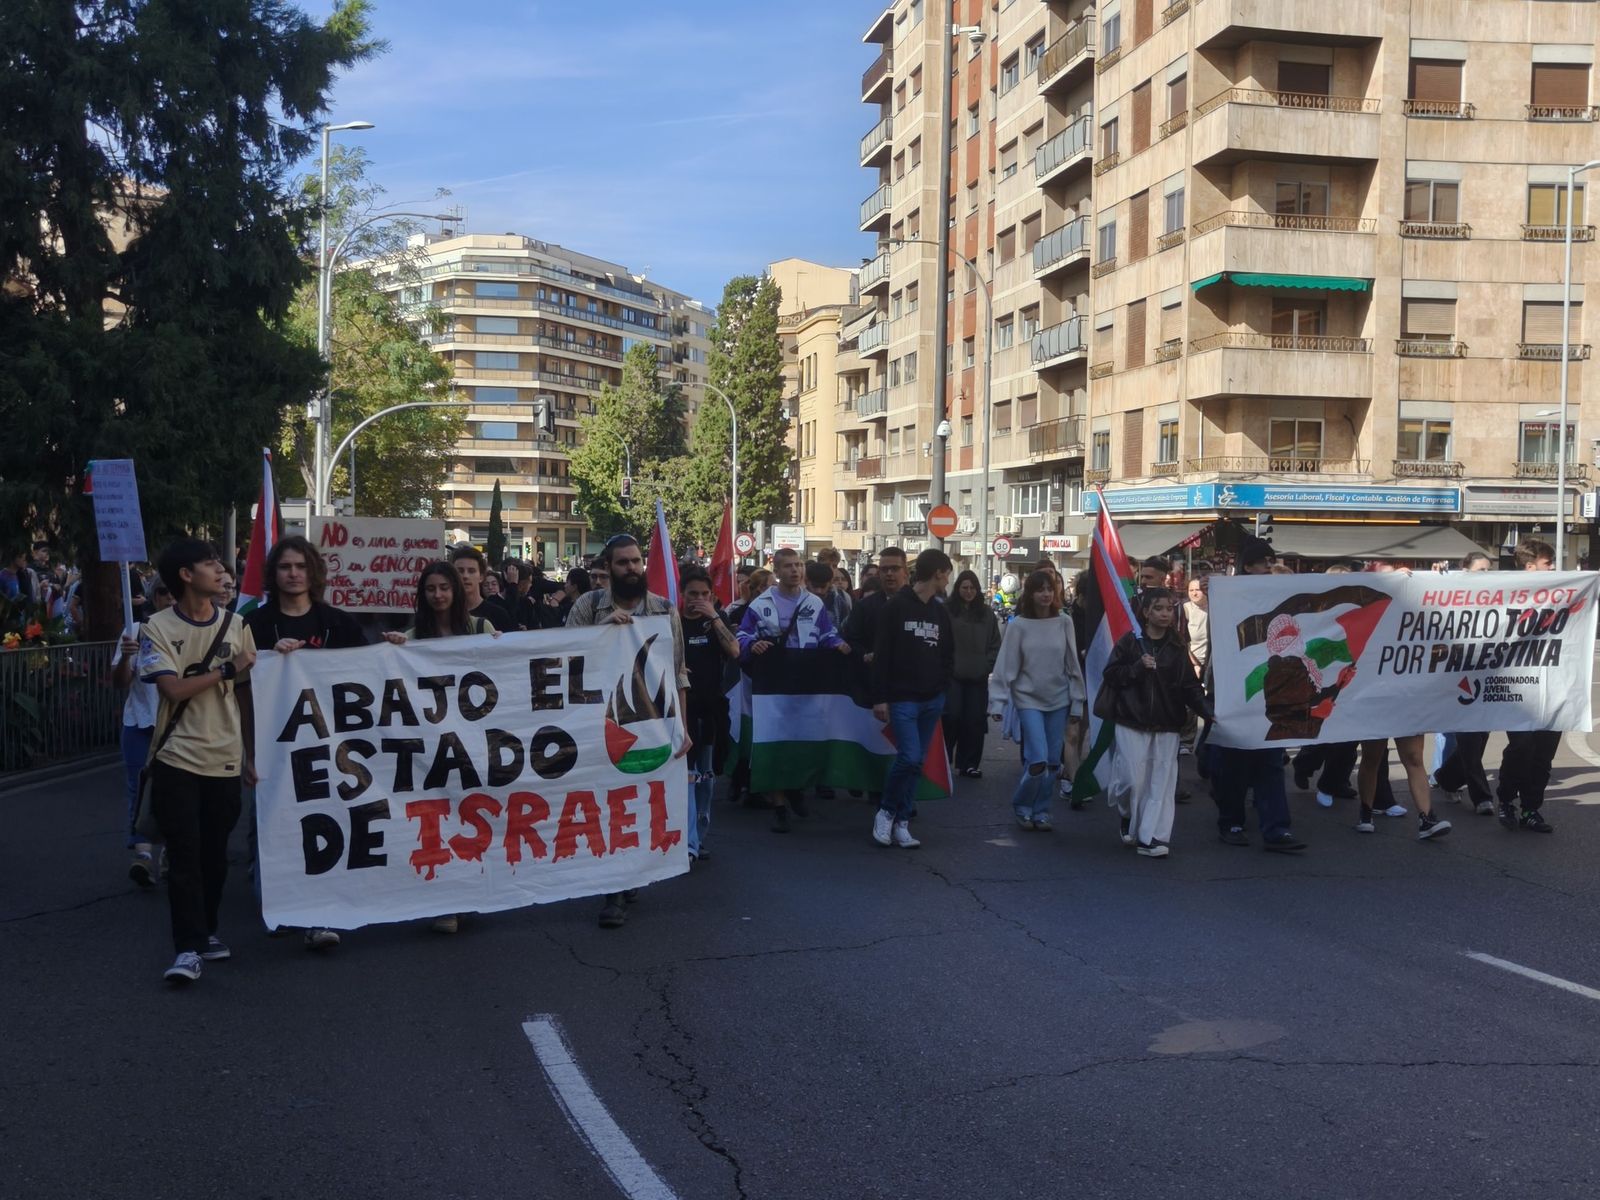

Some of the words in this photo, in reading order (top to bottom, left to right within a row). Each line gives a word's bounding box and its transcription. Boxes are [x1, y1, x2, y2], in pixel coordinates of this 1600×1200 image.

[1264, 493, 1294, 501] Asesoría
[1295, 493, 1324, 502] Laboral,
[1325, 493, 1345, 501] Fiscal
[1385, 495, 1411, 503] Gestión
[1422, 496, 1455, 504] Empresas
[320, 522, 348, 547] NO
[368, 537, 398, 548] una
[370, 555, 442, 573] GENOCID
[332, 589, 417, 608] DESARMA
[1422, 589, 1504, 606] HUELGA
[1509, 589, 1528, 605] 15
[1532, 588, 1578, 605] OCT
[1397, 608, 1500, 642] PARARLO
[1505, 607, 1570, 638] TODO
[1378, 644, 1426, 675] POR
[1428, 639, 1563, 674] PALESTINA
[1483, 685, 1511, 694] JUVENIL
[1484, 676, 1540, 685] COORDINADORA
[276, 671, 499, 743] ABAJO
[529, 655, 604, 712] EL
[1483, 693, 1524, 703] SOCIALISTA
[291, 725, 579, 802] ESTADO
[300, 798, 392, 876] DE
[405, 780, 682, 880] ISRAEL
